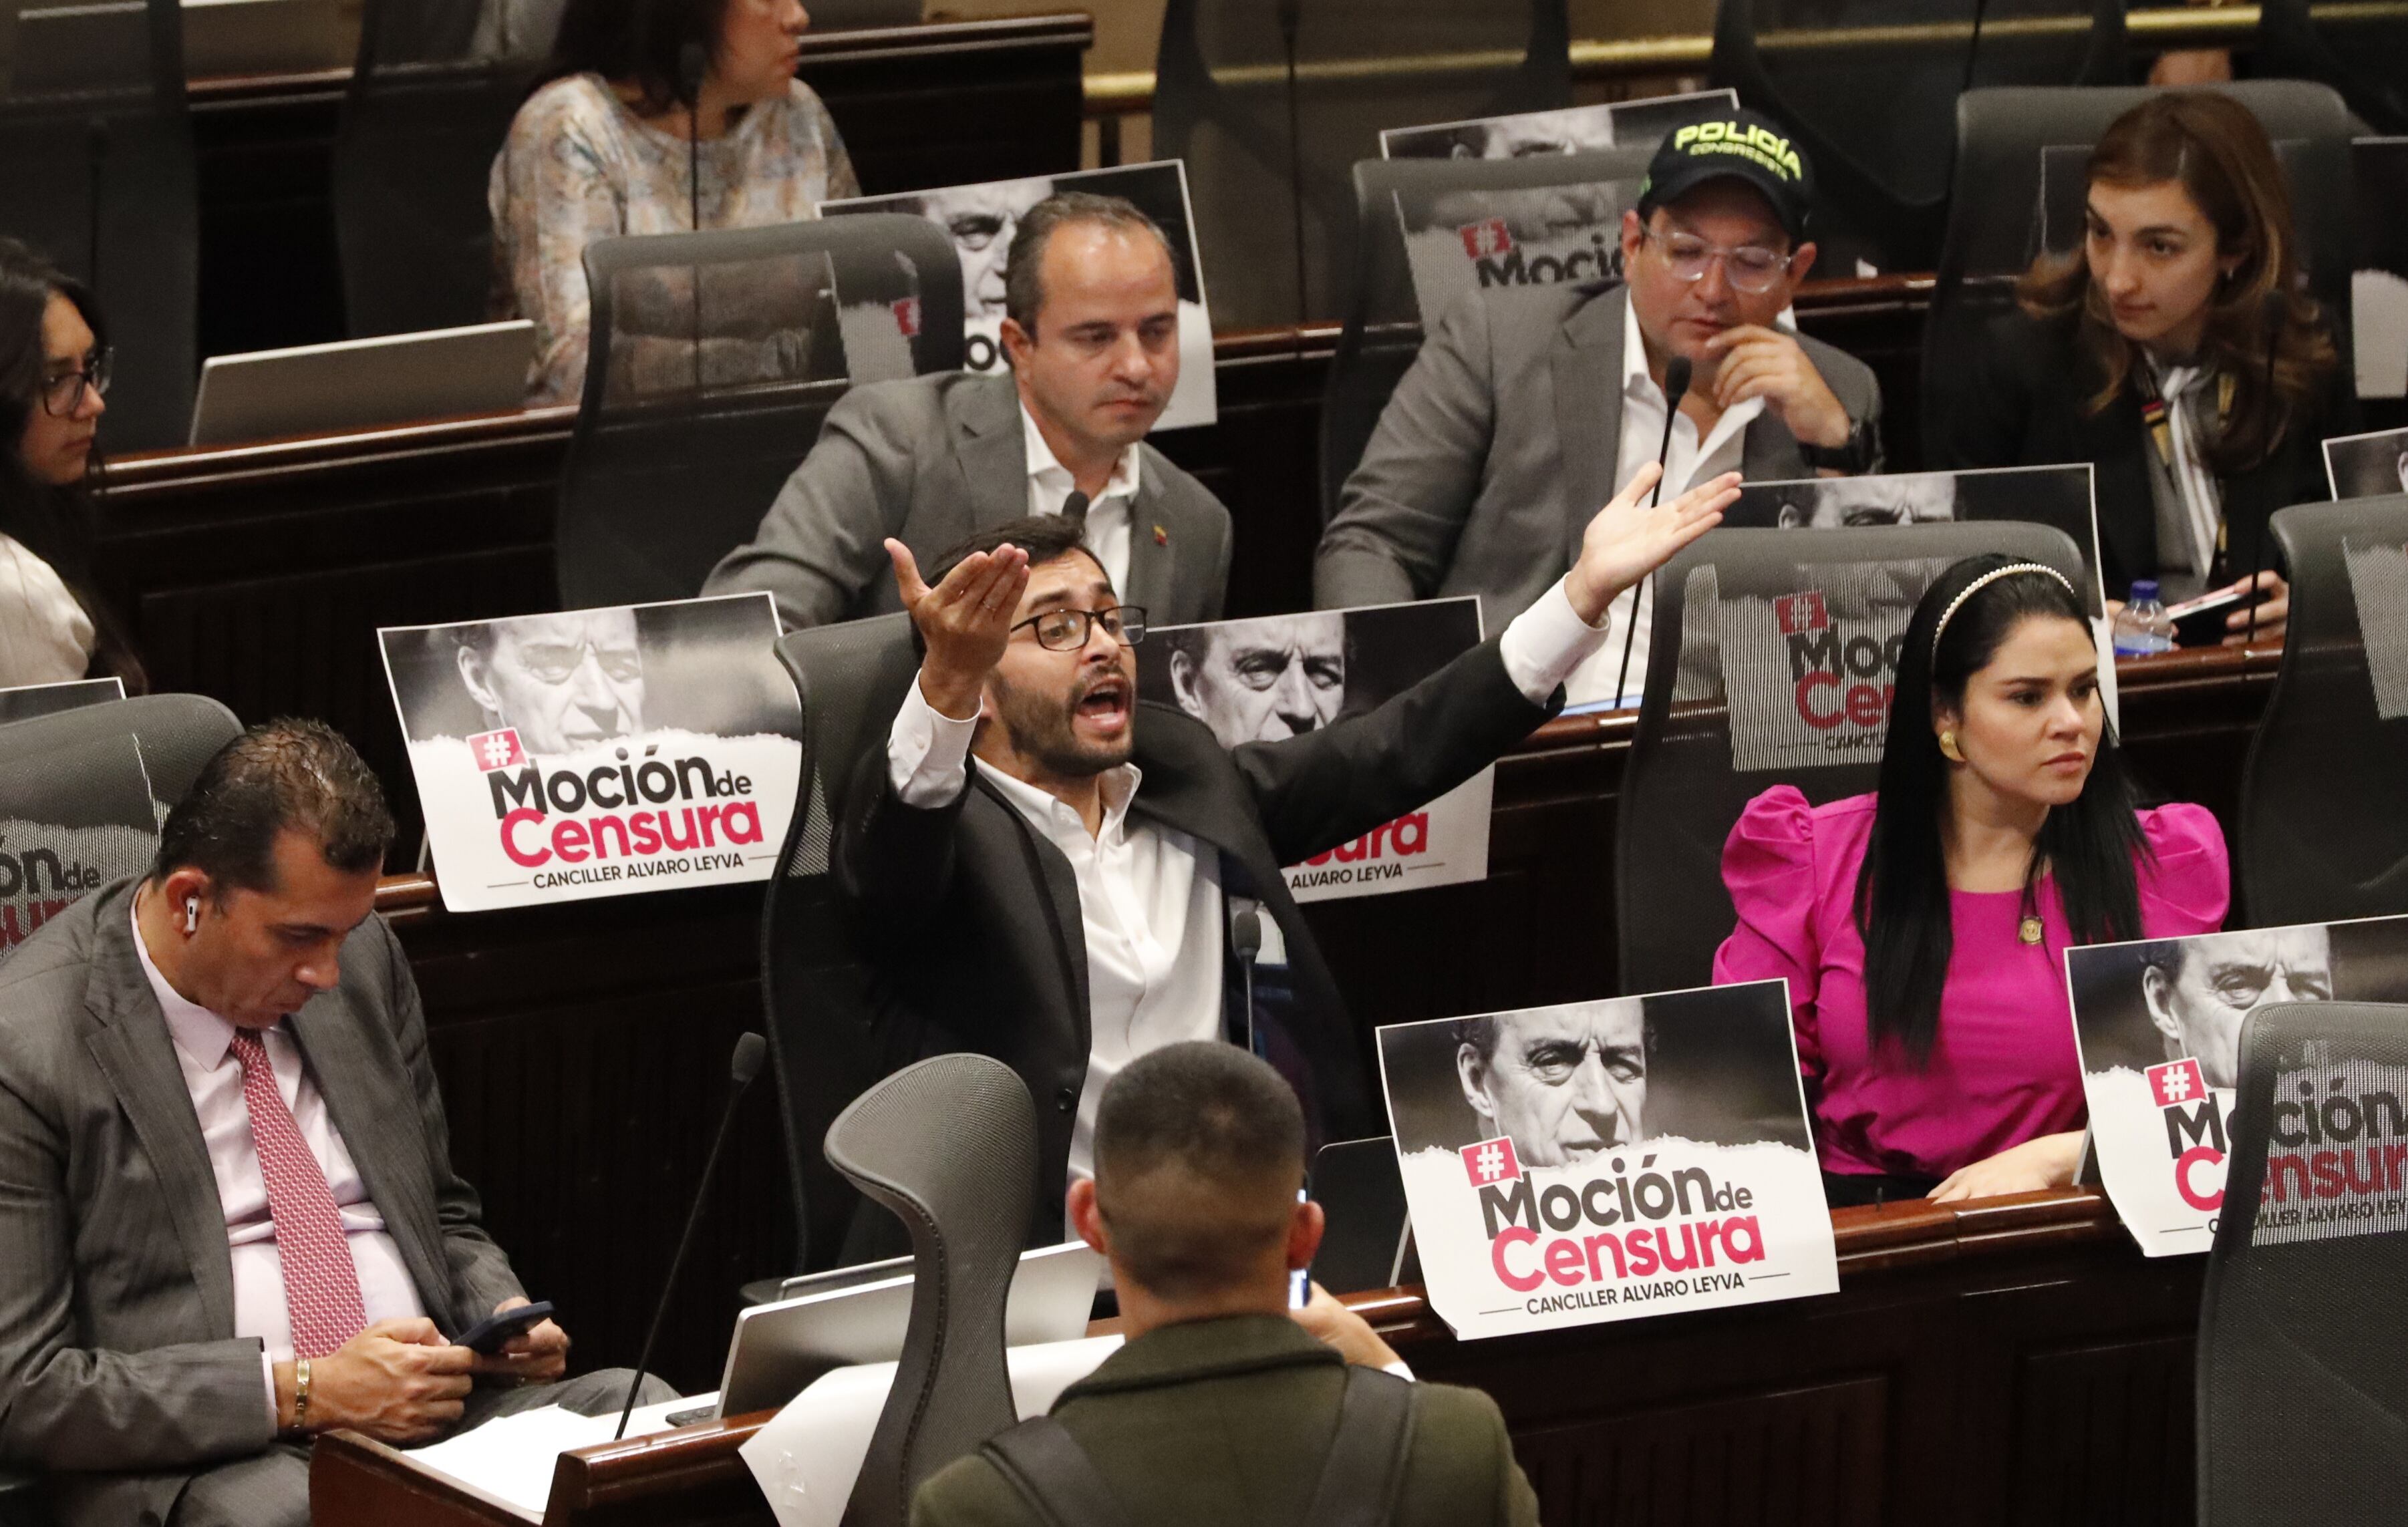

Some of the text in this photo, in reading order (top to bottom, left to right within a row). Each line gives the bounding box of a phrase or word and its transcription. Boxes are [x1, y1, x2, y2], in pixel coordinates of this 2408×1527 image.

[1674, 121, 1802, 182] POLICÍA
[488, 745, 717, 819] Moción
[716, 770, 752, 796] de
[500, 801, 763, 867] Censura
[534, 853, 744, 889] CANCILLER ALVARO LEYVA
[1291, 863, 1403, 889] ALVARO LEYVA
[1479, 1154, 1716, 1240] Moción
[1715, 1181, 1753, 1211] de
[1491, 1215, 1765, 1292] Censura
[1527, 1272, 1745, 1315] CANCILLER ALVARO LEYVA
